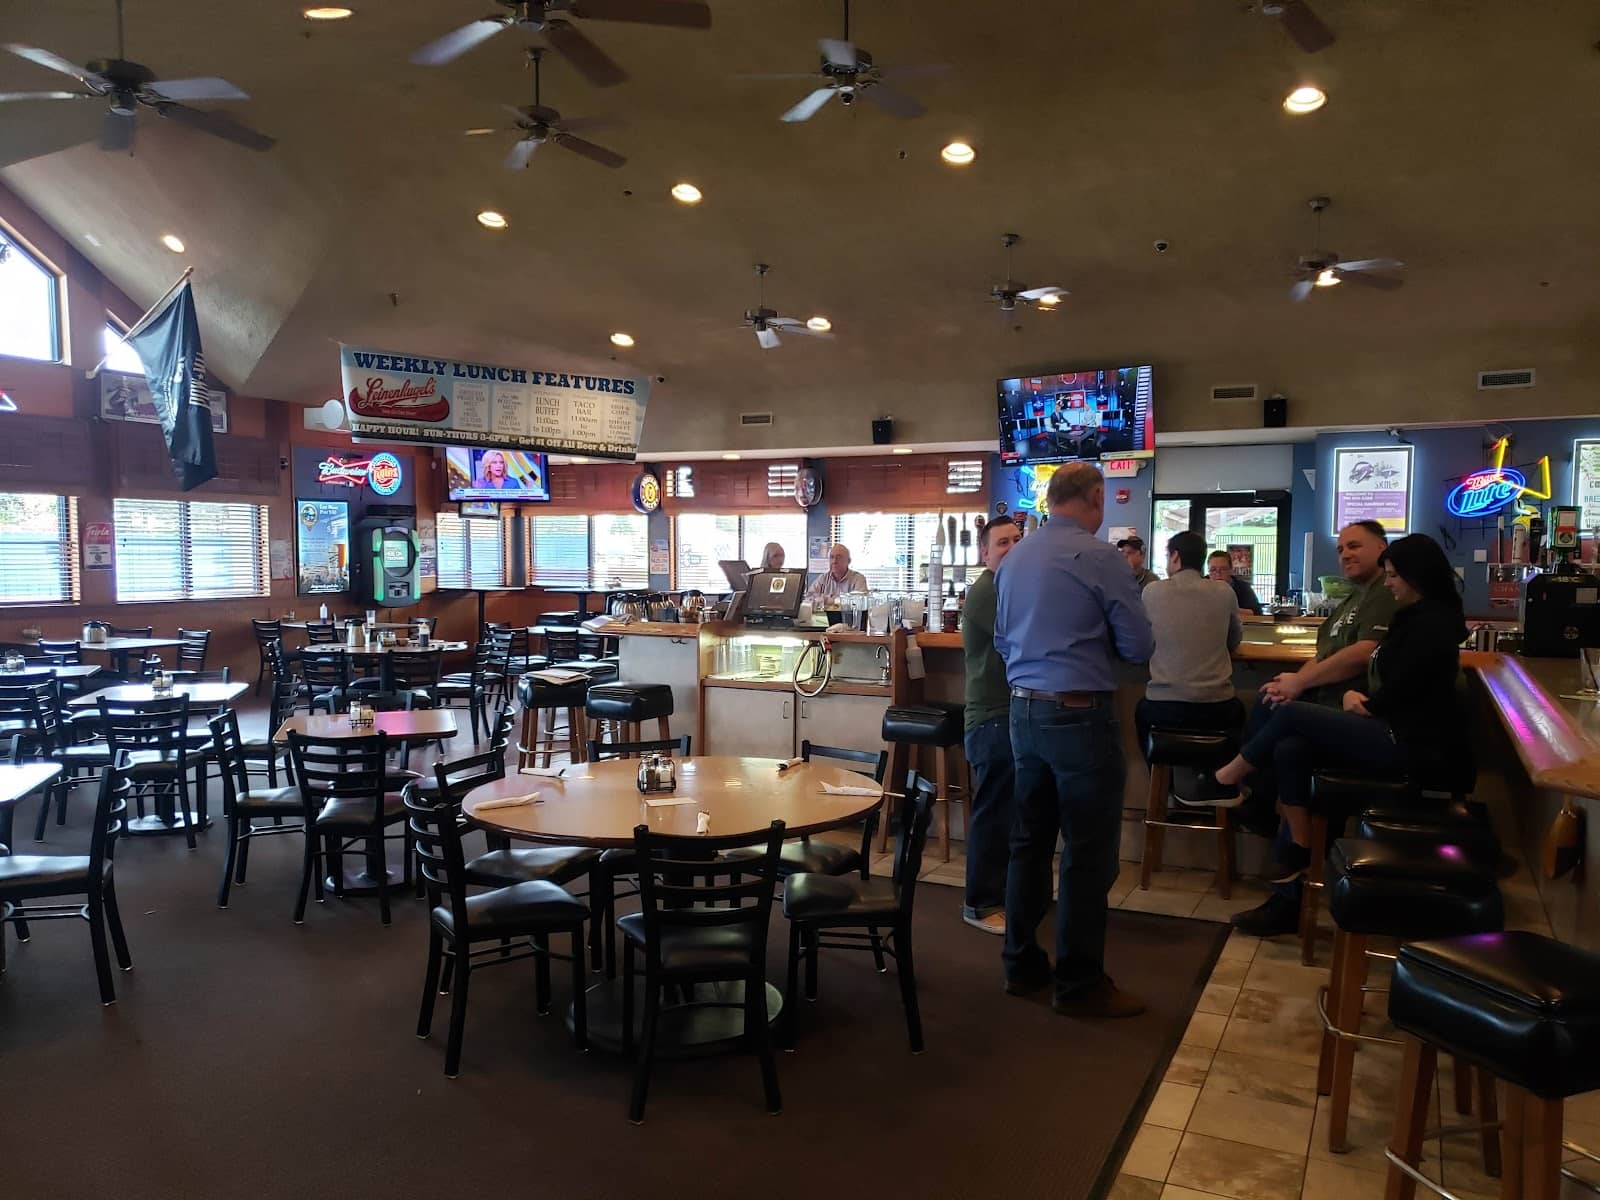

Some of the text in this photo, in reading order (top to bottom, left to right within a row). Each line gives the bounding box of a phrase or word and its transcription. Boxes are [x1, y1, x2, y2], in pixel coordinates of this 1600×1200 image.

[353, 352, 635, 395] WEEKLY LUNCH FEATURES
[536, 397, 560, 407] LUNCH
[573, 400, 596, 409] TACO
[536, 406, 560, 416] BUFFET
[352, 423, 386, 433] HAPPY
[388, 425, 420, 435] HOUR!
[519, 437, 535, 445] Get
[546, 439, 561, 447] Off
[562, 440, 575, 448] All
[576, 442, 598, 450] Beer
[1110, 460, 1131, 469] EXIT
[1459, 481, 1514, 514] Lite
